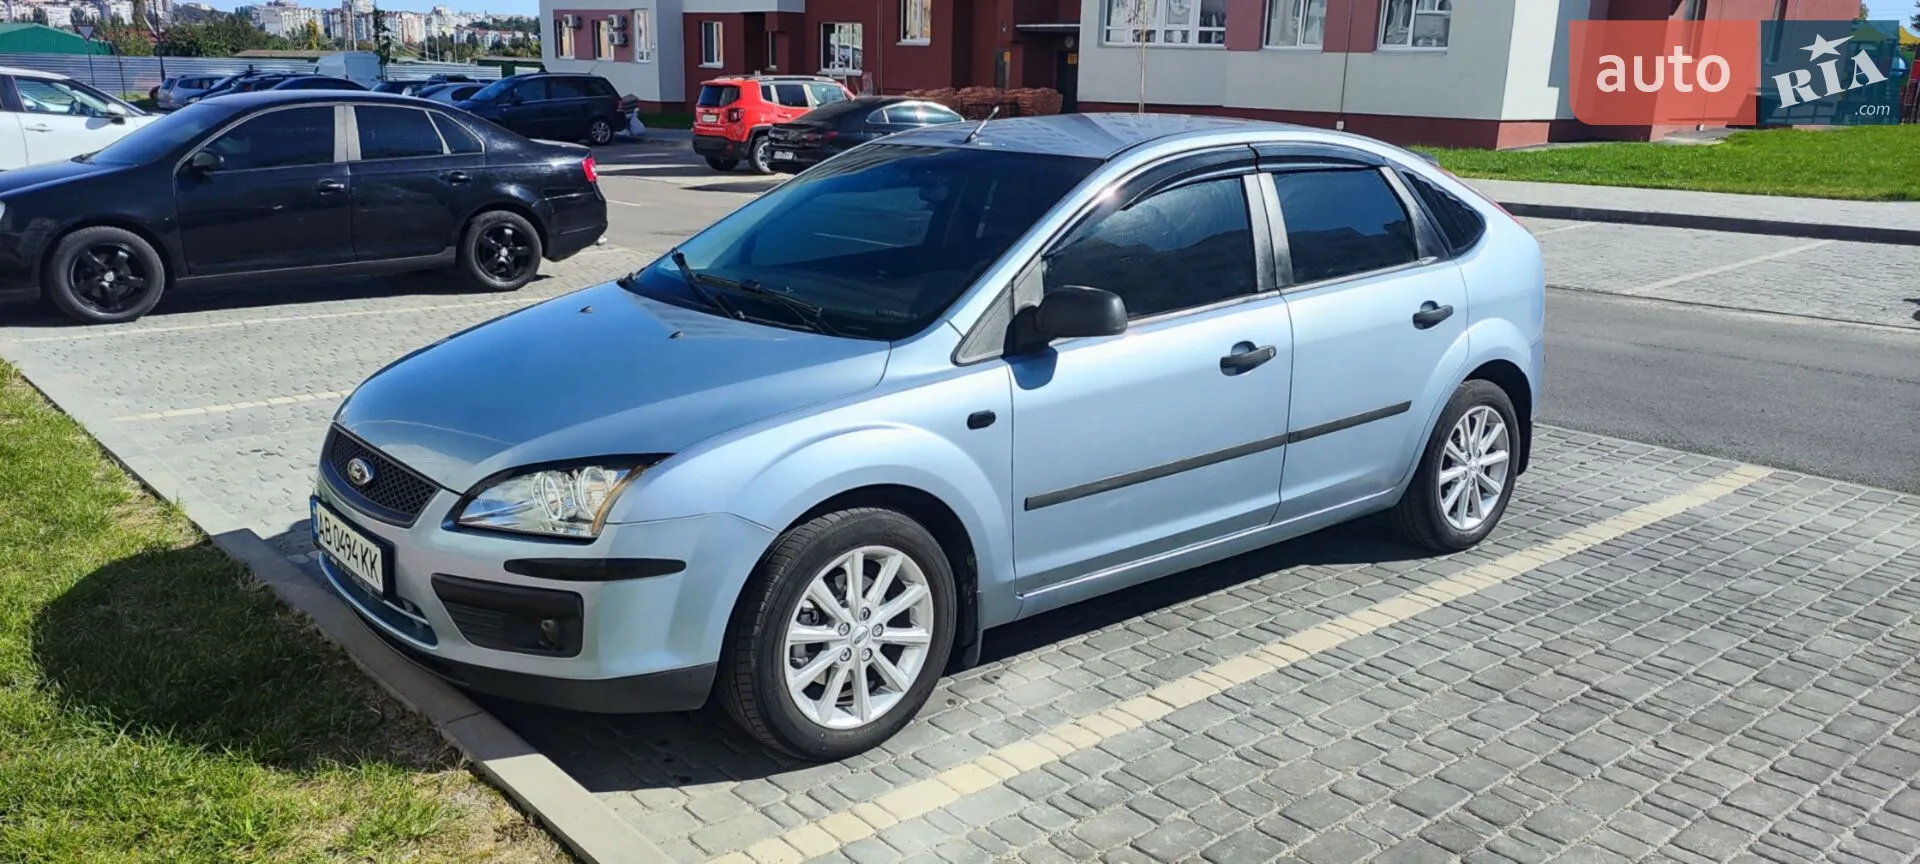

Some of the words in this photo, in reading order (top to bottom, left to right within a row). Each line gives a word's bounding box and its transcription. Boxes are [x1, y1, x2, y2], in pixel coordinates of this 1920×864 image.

[319, 511, 332, 545] AB
[333, 523, 359, 568] 0494
[360, 543, 380, 585] KK
